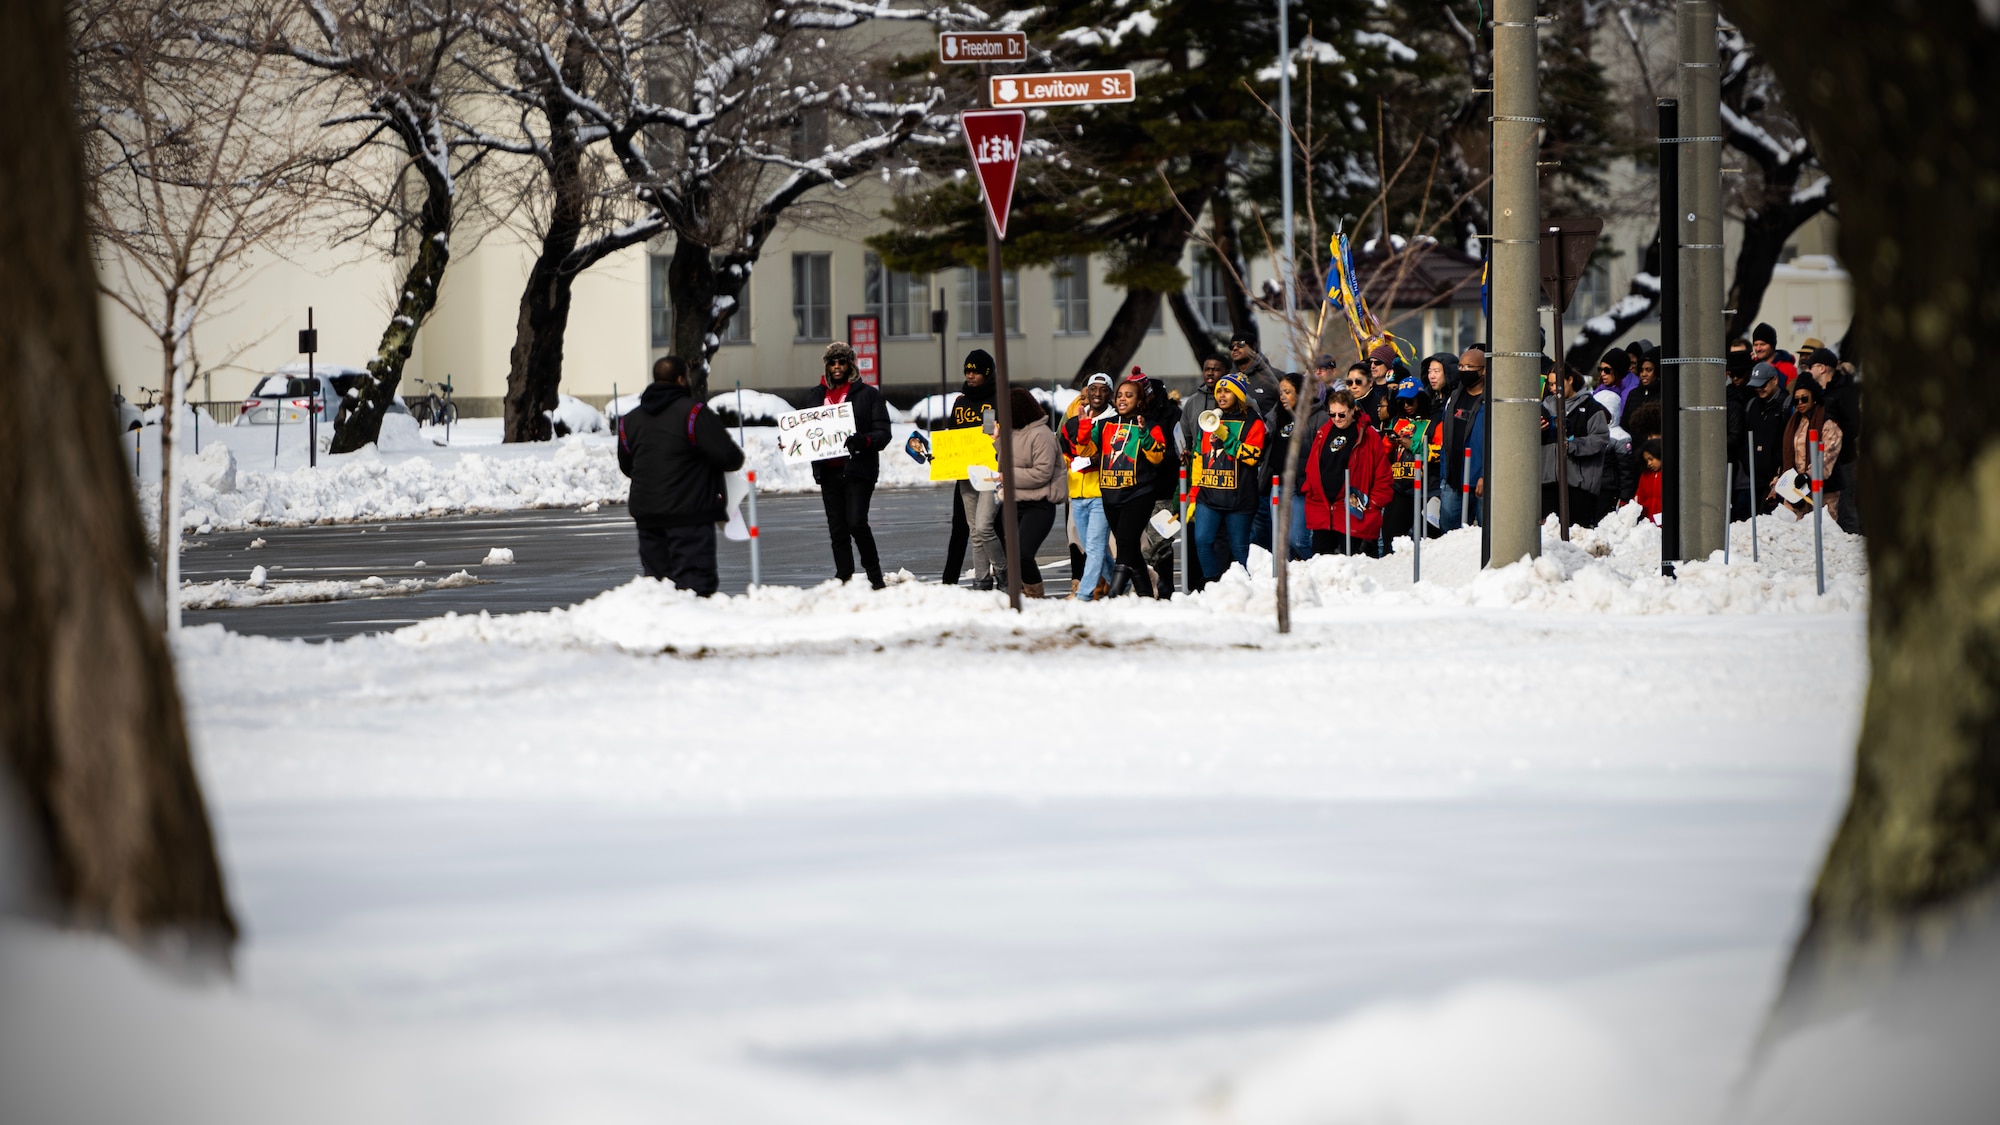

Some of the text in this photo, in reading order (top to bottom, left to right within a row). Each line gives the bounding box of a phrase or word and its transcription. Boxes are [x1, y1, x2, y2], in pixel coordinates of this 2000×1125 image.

[961, 38, 1021, 56] Freedom Dr.
[1023, 77, 1126, 99] Levitow St.
[977, 134, 1016, 164] 止まれ
[780, 404, 850, 431] CELEBRATE
[1100, 476, 1118, 486] KING
[1198, 475, 1234, 487] KING JR
